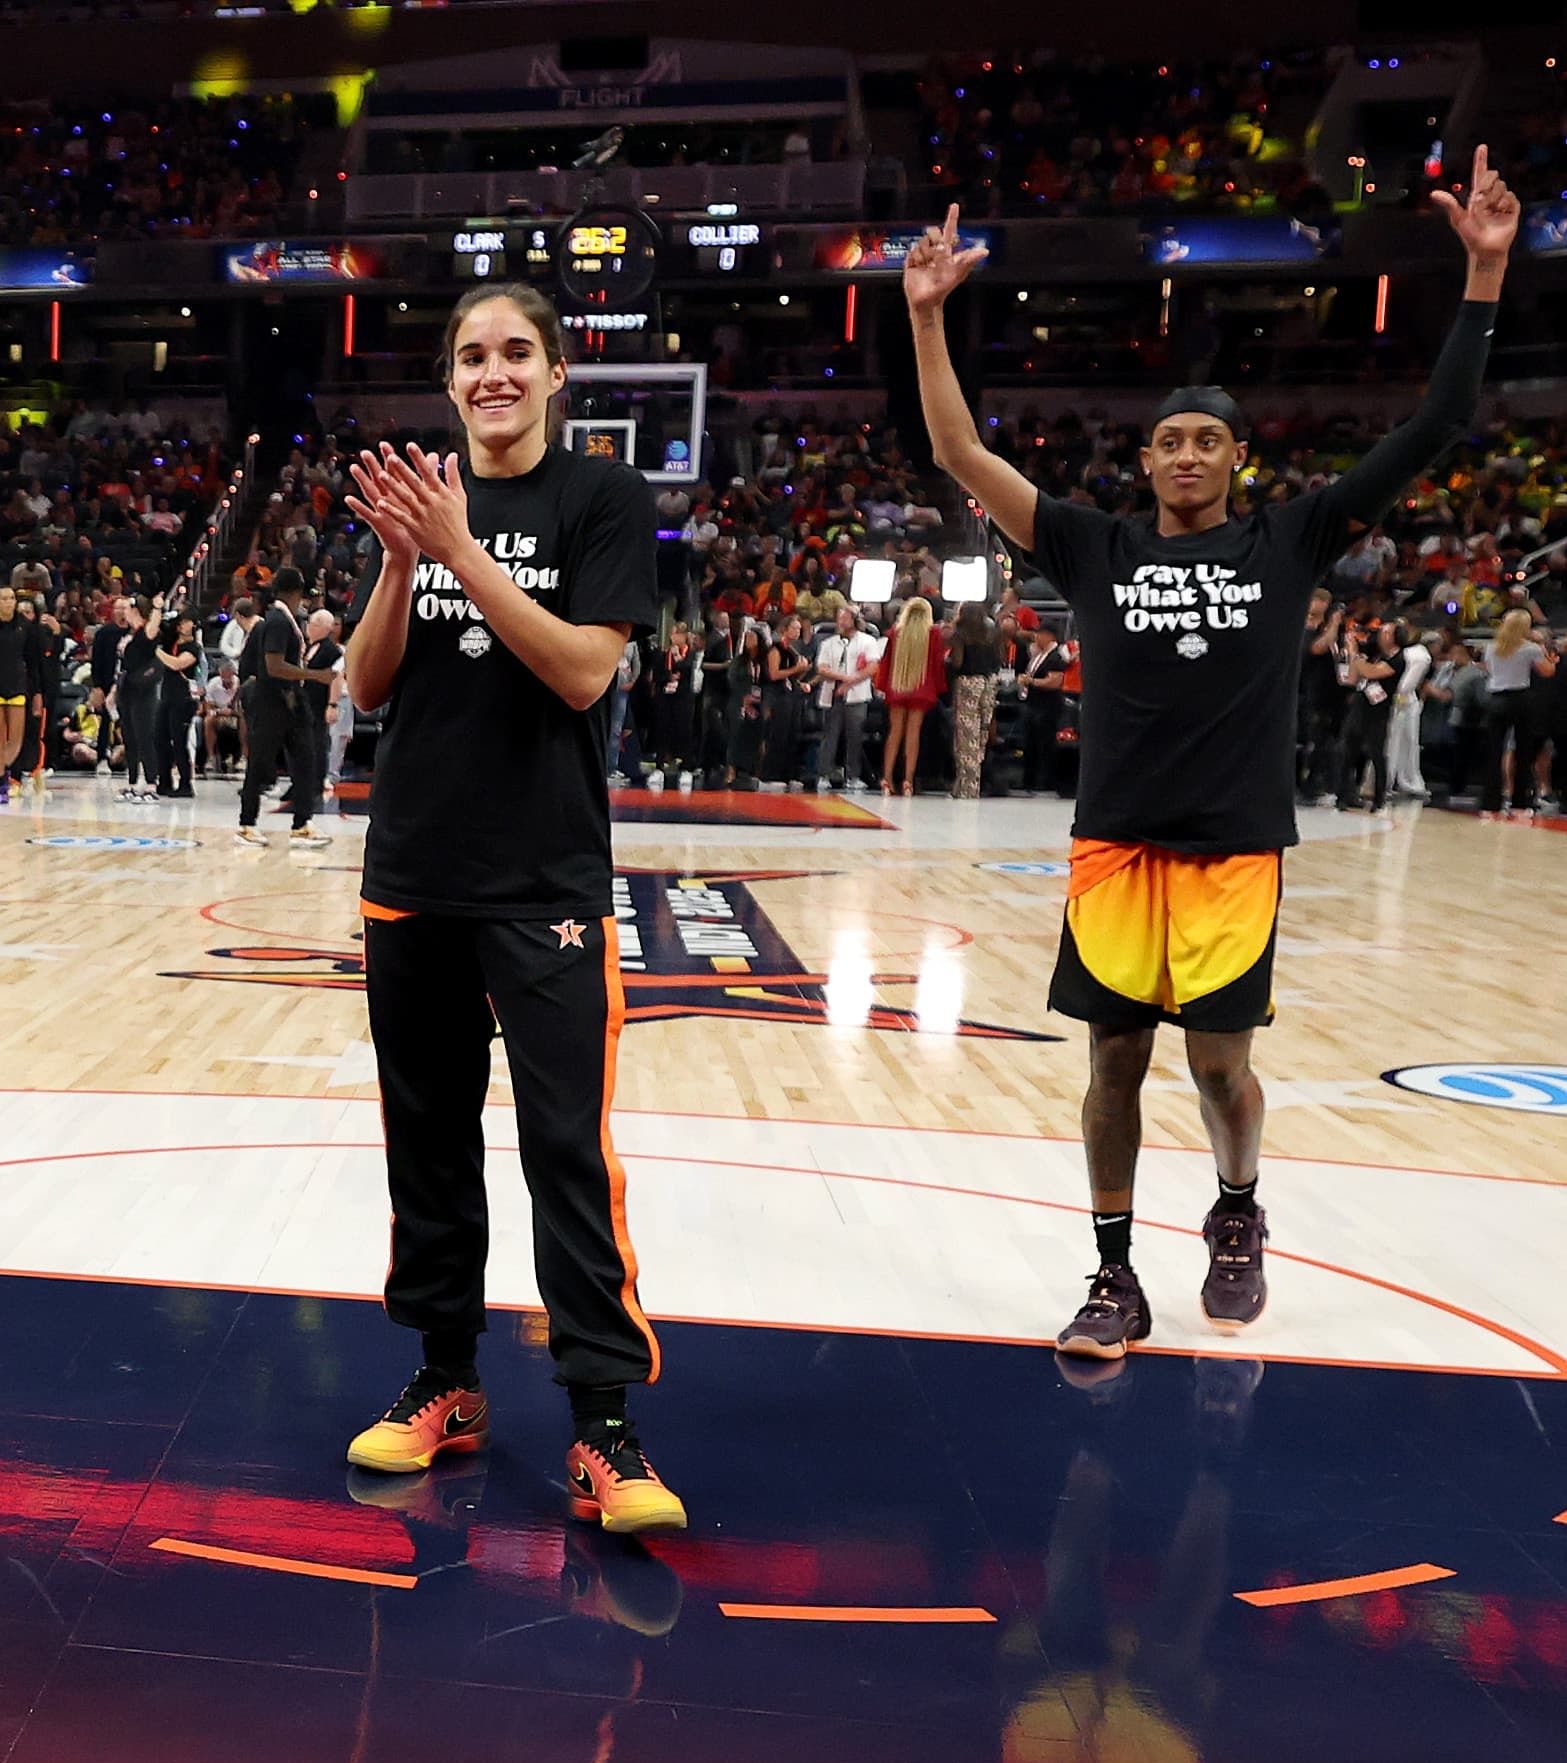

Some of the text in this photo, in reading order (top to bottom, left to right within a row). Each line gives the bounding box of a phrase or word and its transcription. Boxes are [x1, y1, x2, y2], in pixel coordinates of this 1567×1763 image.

[560, 87, 645, 107] FLIGHT
[454, 232, 504, 252] CLARK
[689, 225, 760, 246] COLLIER
[585, 314, 648, 330] TISSOT
[494, 532, 537, 559] Us
[1133, 564, 1192, 589] Pay
[1112, 580, 1263, 608] What You
[1124, 605, 1249, 633] Owe Us
[676, 919, 759, 957] INDY
